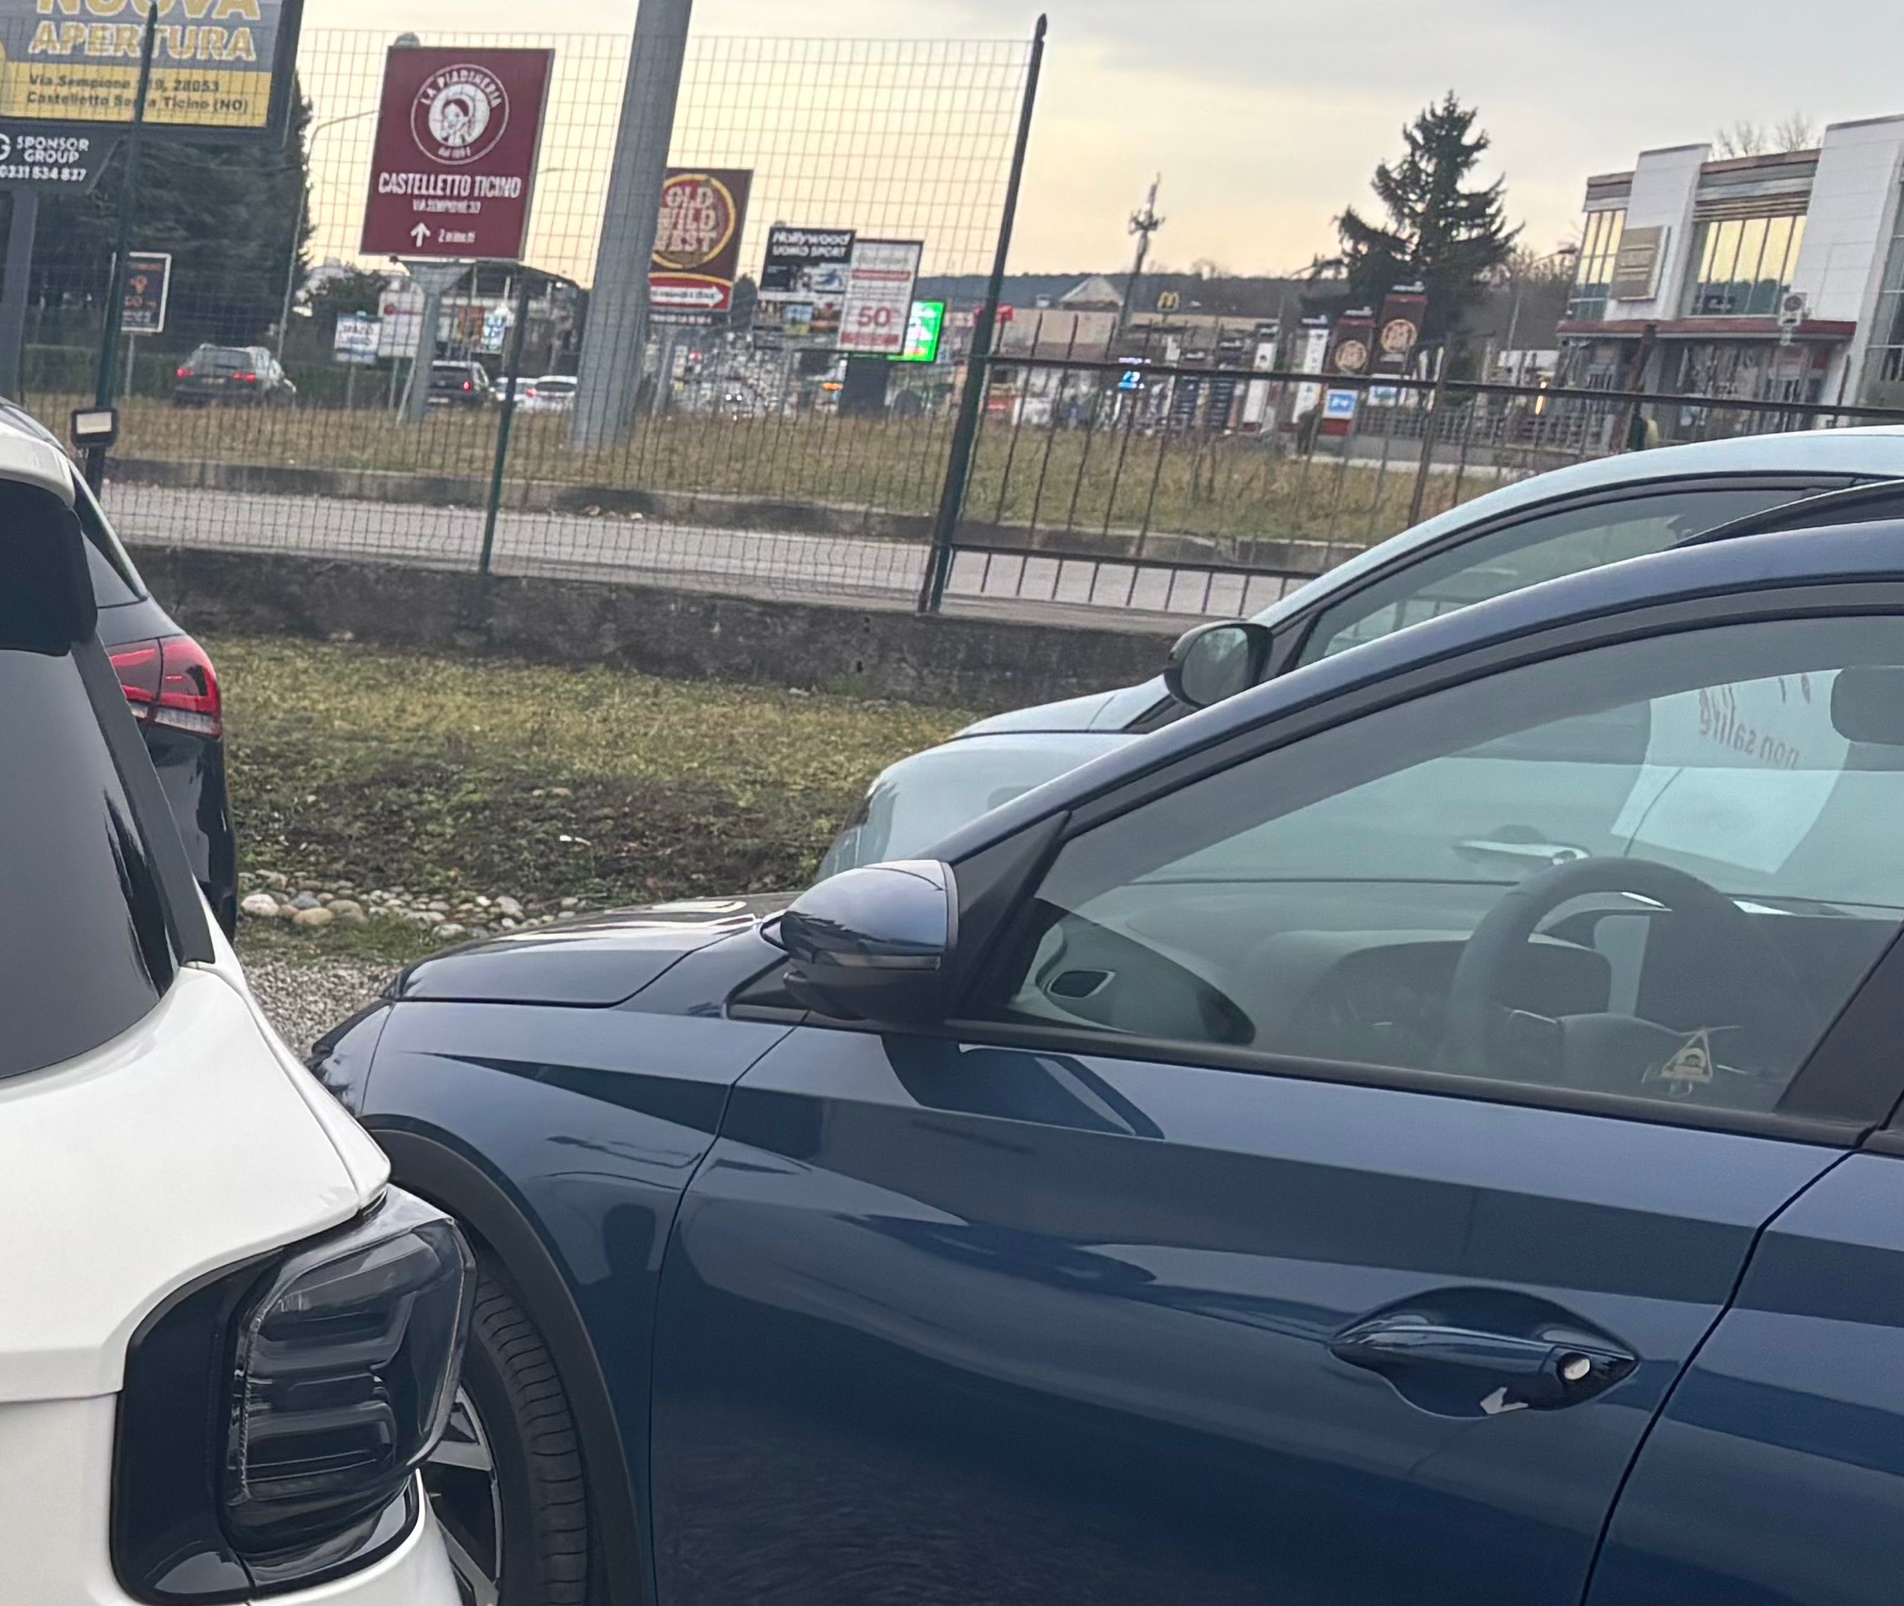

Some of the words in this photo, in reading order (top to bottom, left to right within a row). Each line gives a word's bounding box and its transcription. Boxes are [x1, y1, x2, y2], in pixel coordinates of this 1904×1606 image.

[420, 87, 438, 105] LA
[16, 135, 90, 151] SPONSOR
[23, 149, 80, 164] GROUP
[378, 172, 471, 196] CASTELLETTO
[474, 175, 522, 198] TICINO
[666, 186, 714, 208] OLD
[772, 230, 851, 246] Hollywood
